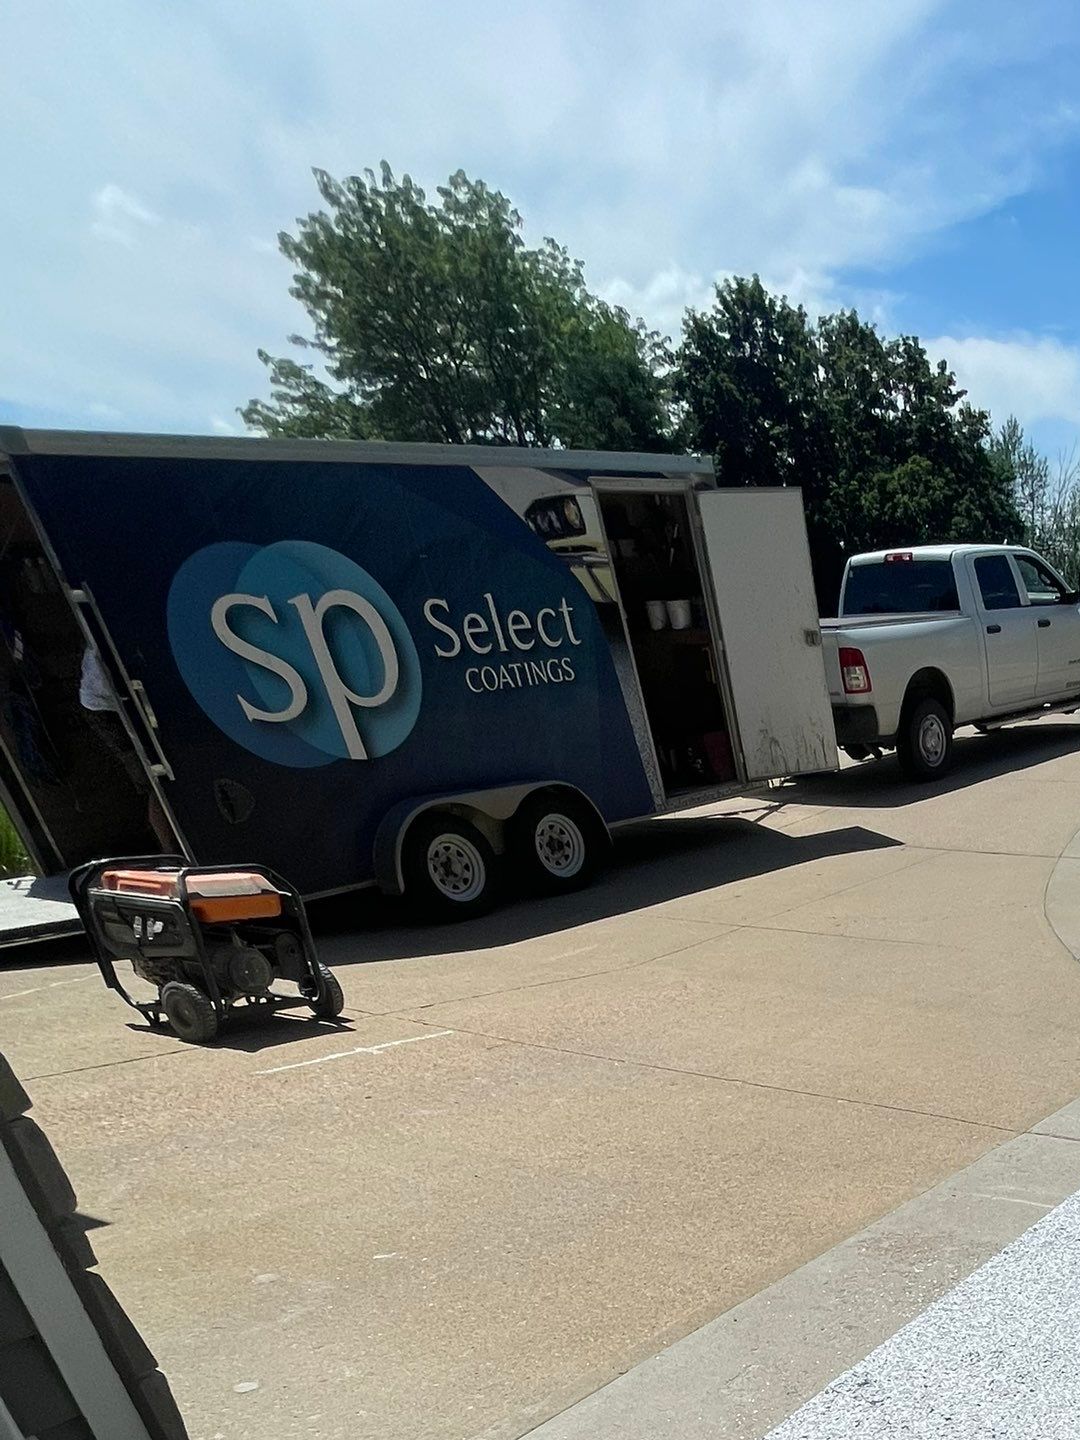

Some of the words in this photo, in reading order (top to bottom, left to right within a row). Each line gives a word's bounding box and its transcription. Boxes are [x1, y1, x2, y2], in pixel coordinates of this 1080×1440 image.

[423, 593, 582, 658] Select
[211, 589, 399, 760] sp
[466, 657, 576, 693] COATINGS
